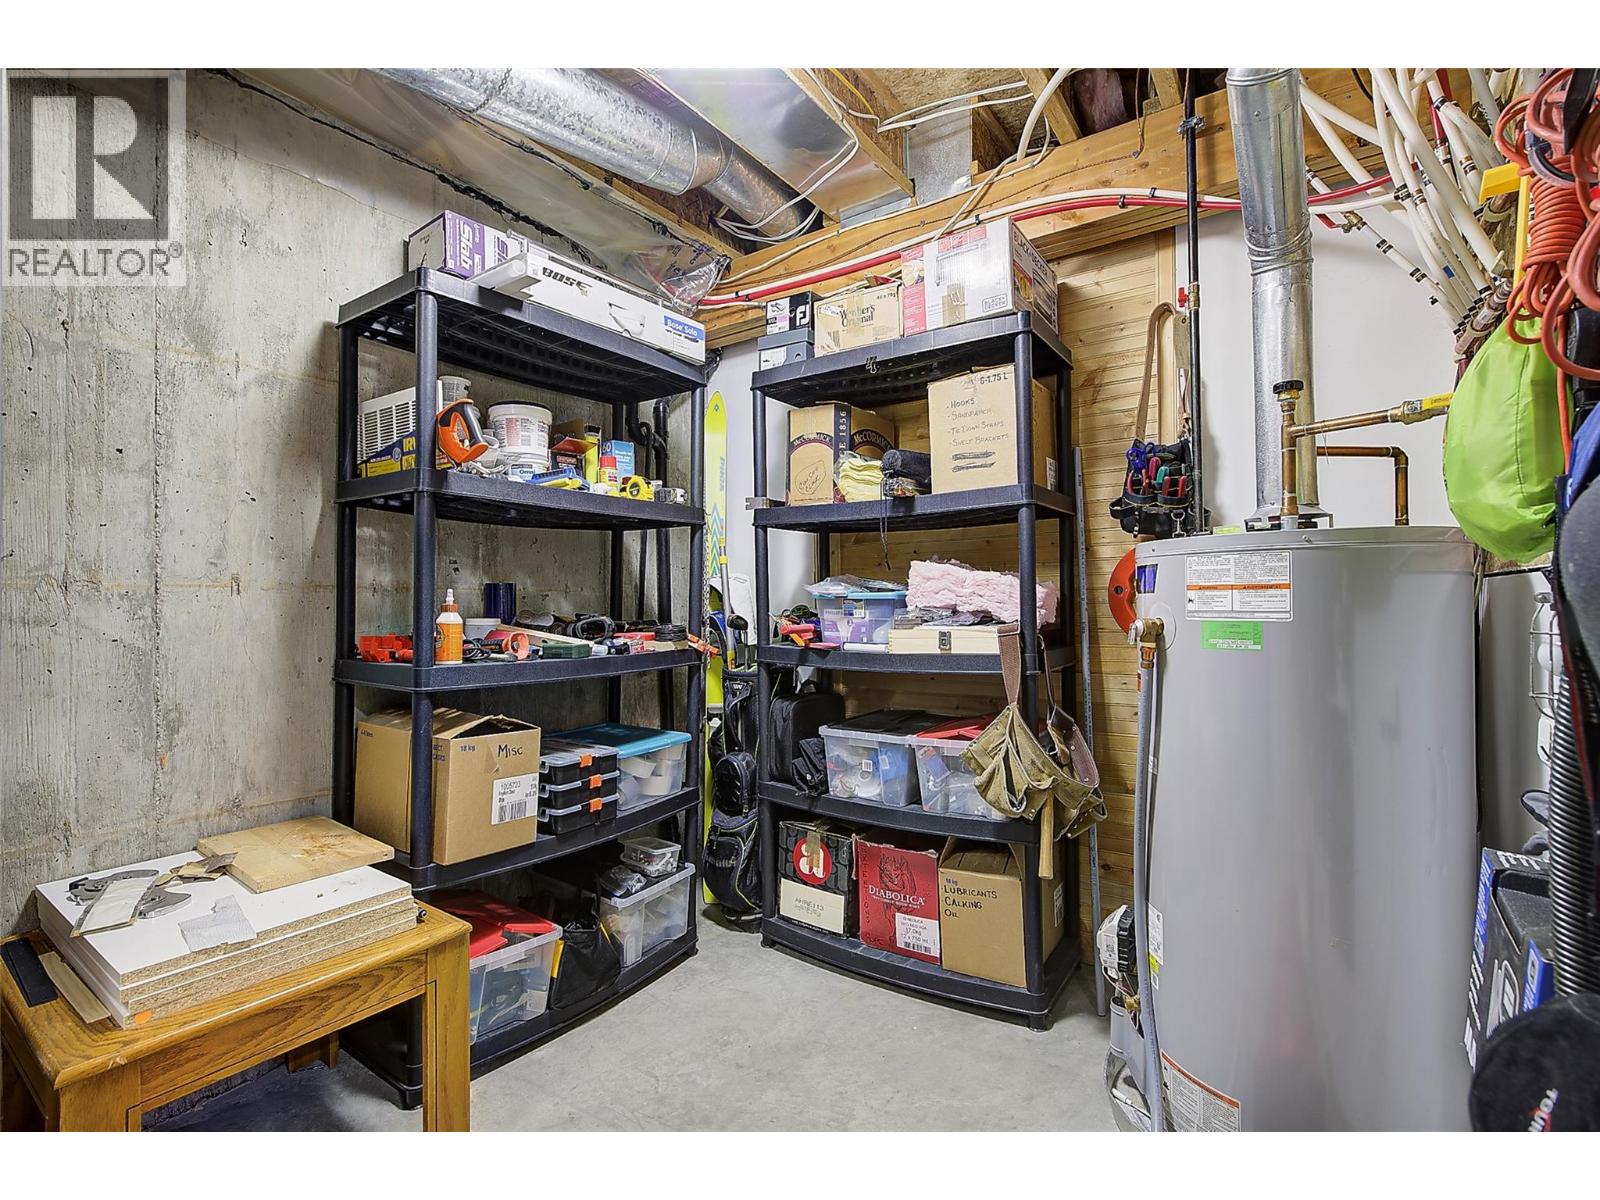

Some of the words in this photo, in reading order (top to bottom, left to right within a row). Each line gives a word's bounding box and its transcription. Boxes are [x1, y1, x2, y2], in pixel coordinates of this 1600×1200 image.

[542, 266, 593, 294] BOSE
[839, 410, 847, 436] 1856
[868, 884, 925, 906] DIABOLICA
[943, 884, 998, 899] LUBRICANTS
[944, 896, 983, 909] CALKING
